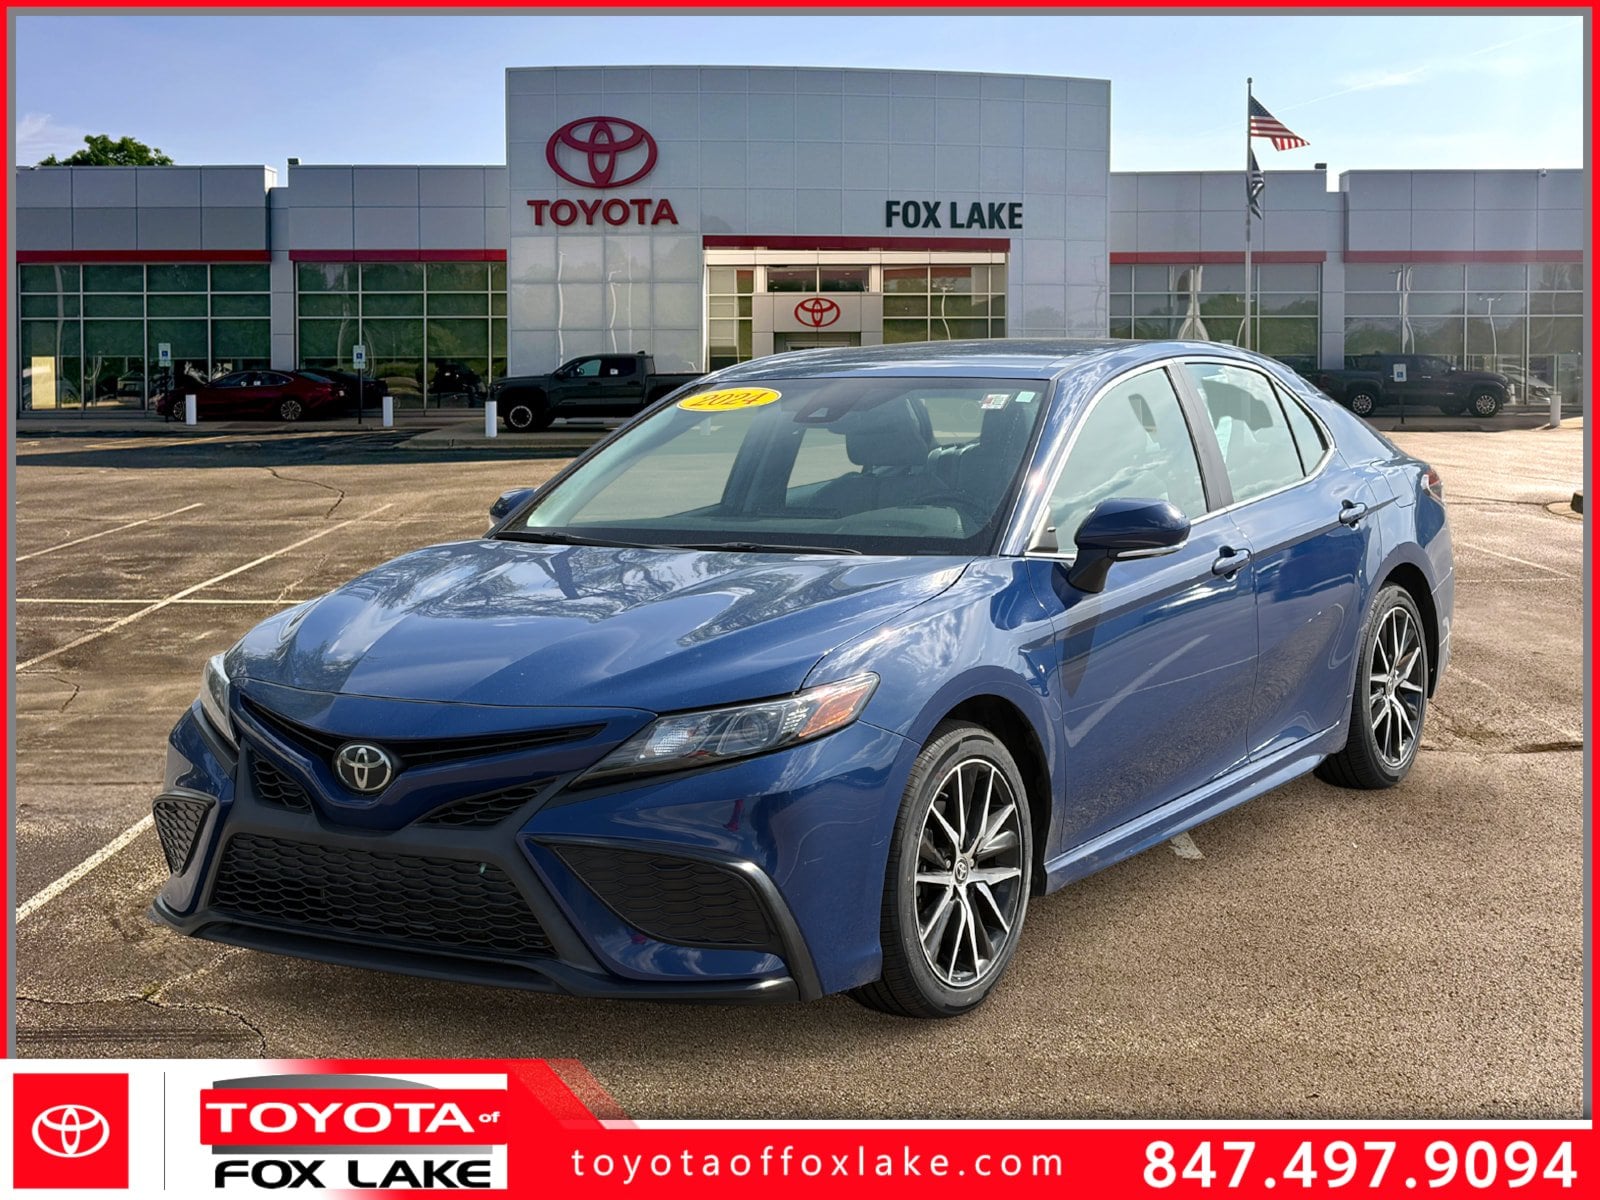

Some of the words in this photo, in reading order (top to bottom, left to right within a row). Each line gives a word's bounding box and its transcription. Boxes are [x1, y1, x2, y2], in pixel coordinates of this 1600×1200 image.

[527, 199, 679, 227] TOYOTA
[885, 200, 942, 229] FOX
[950, 201, 1023, 230] LAKE
[689, 392, 769, 407] 2024
